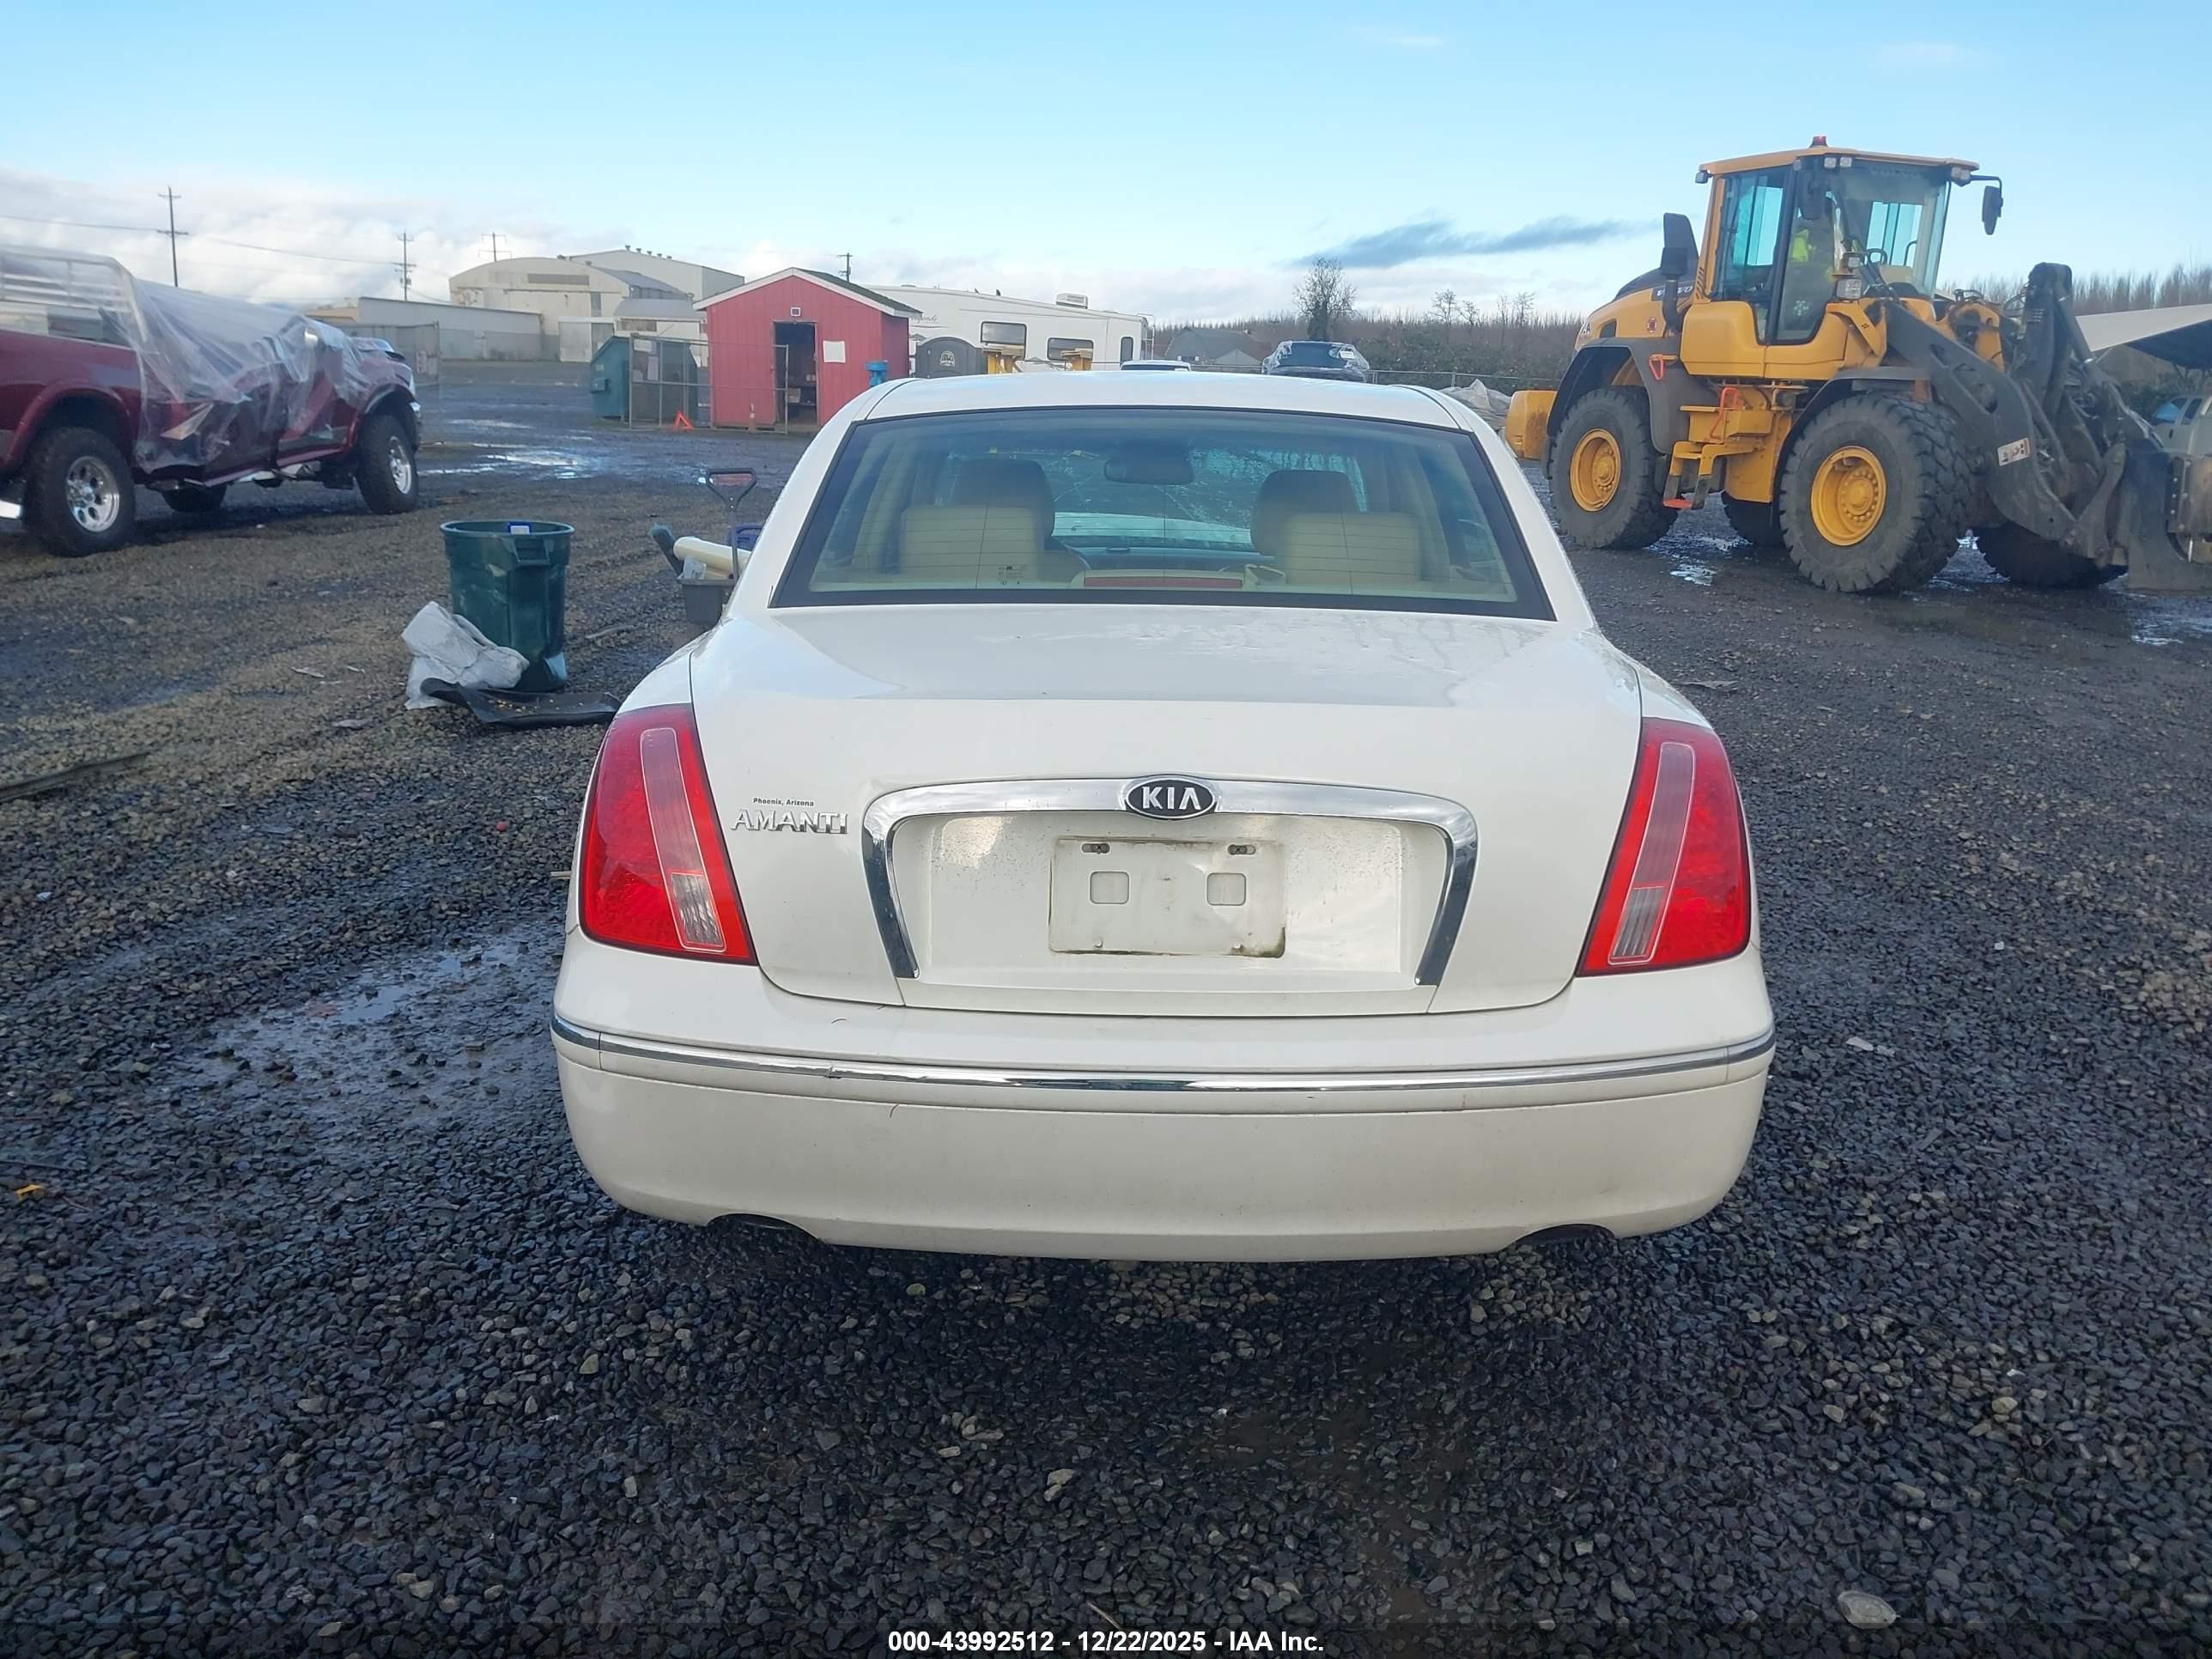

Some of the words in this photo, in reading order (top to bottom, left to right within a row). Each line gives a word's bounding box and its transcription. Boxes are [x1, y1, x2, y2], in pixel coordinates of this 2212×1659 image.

[753, 797, 784, 805] Phoenix,
[1141, 786, 1201, 810] KIA
[730, 809, 848, 835] AMANTI
